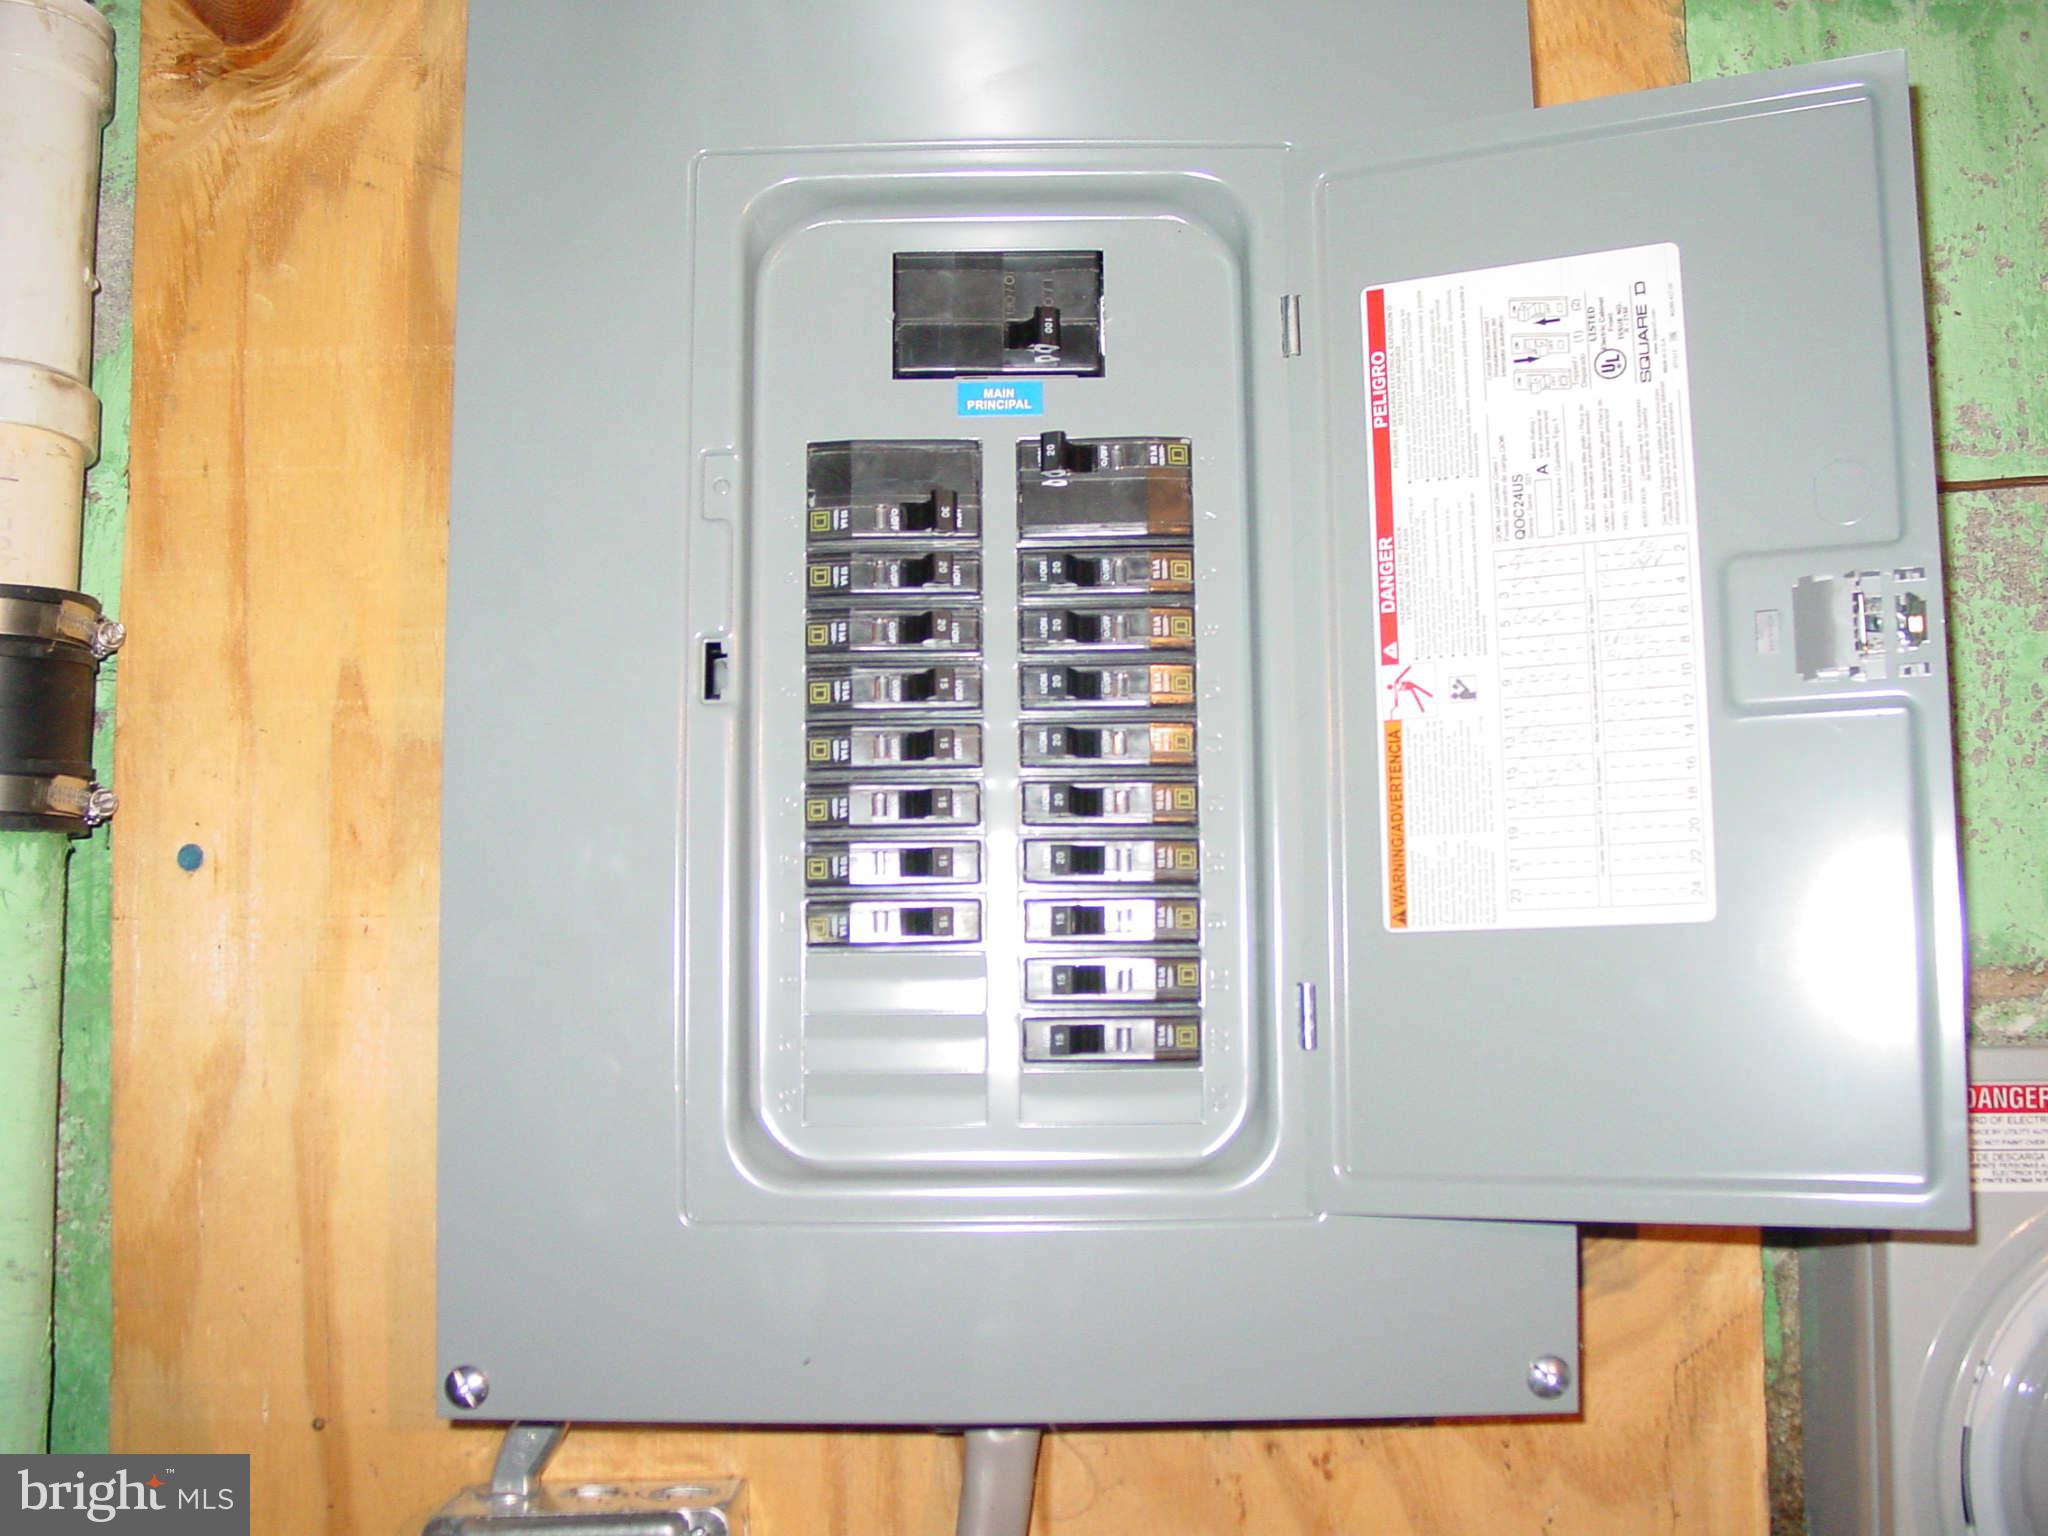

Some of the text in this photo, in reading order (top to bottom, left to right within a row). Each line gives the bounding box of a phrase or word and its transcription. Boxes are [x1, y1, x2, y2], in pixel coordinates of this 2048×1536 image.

[1634, 280, 1647, 295] D
[1570, 298, 1582, 312] (2)
[1044, 318, 1053, 334] 100
[1588, 306, 1597, 342] LISTED
[1572, 330, 1585, 343] (1)
[1636, 304, 1652, 383] SQUARE
[1600, 354, 1621, 373] UL
[983, 388, 1014, 398] MAIN
[1372, 351, 1387, 428] PELIGRO
[968, 400, 1032, 410] PRINCIPAL
[1047, 444, 1056, 456] 20
[1536, 463, 1549, 475] A
[941, 506, 950, 518] 30
[1511, 473, 1526, 540] QOC24US
[1674, 544, 1685, 553] 2
[939, 562, 947, 573] 20
[1053, 562, 1061, 573] 20
[1378, 537, 1396, 613] DANGER
[1676, 576, 1686, 584] 4
[1498, 591, 1509, 599] 3
[1679, 605, 1688, 614] 6
[937, 619, 946, 631] 20
[1052, 620, 1061, 631] 20
[1500, 619, 1511, 627] 5
[1680, 635, 1690, 643] 8
[1682, 662, 1693, 676] 10
[940, 678, 948, 688] 15
[1052, 675, 1061, 687] 20
[1502, 679, 1512, 687] 9
[1683, 693, 1694, 707] 12
[1504, 707, 1514, 719] 11
[1684, 722, 1696, 737] 14
[940, 738, 948, 748] 15
[1052, 734, 1061, 746] 20
[1505, 735, 1516, 749] 13
[1686, 756, 1697, 770] 16
[1506, 767, 1517, 780] 15
[1688, 786, 1698, 800] 18
[938, 796, 947, 808] 15
[1054, 793, 1064, 806] 20
[1507, 796, 1518, 810] 17
[1388, 729, 1405, 908] WARNING/ADVERTENCIA
[1689, 817, 1700, 832] 20
[1508, 827, 1519, 840] 19
[939, 857, 948, 867] 15
[1056, 852, 1065, 864] 20
[1691, 848, 1702, 864] 22
[1509, 858, 1520, 872] 21
[1692, 880, 1703, 897] 24
[1510, 888, 1521, 903] 23
[1057, 974, 1066, 985] 15
[1056, 1034, 1064, 1046] 15
